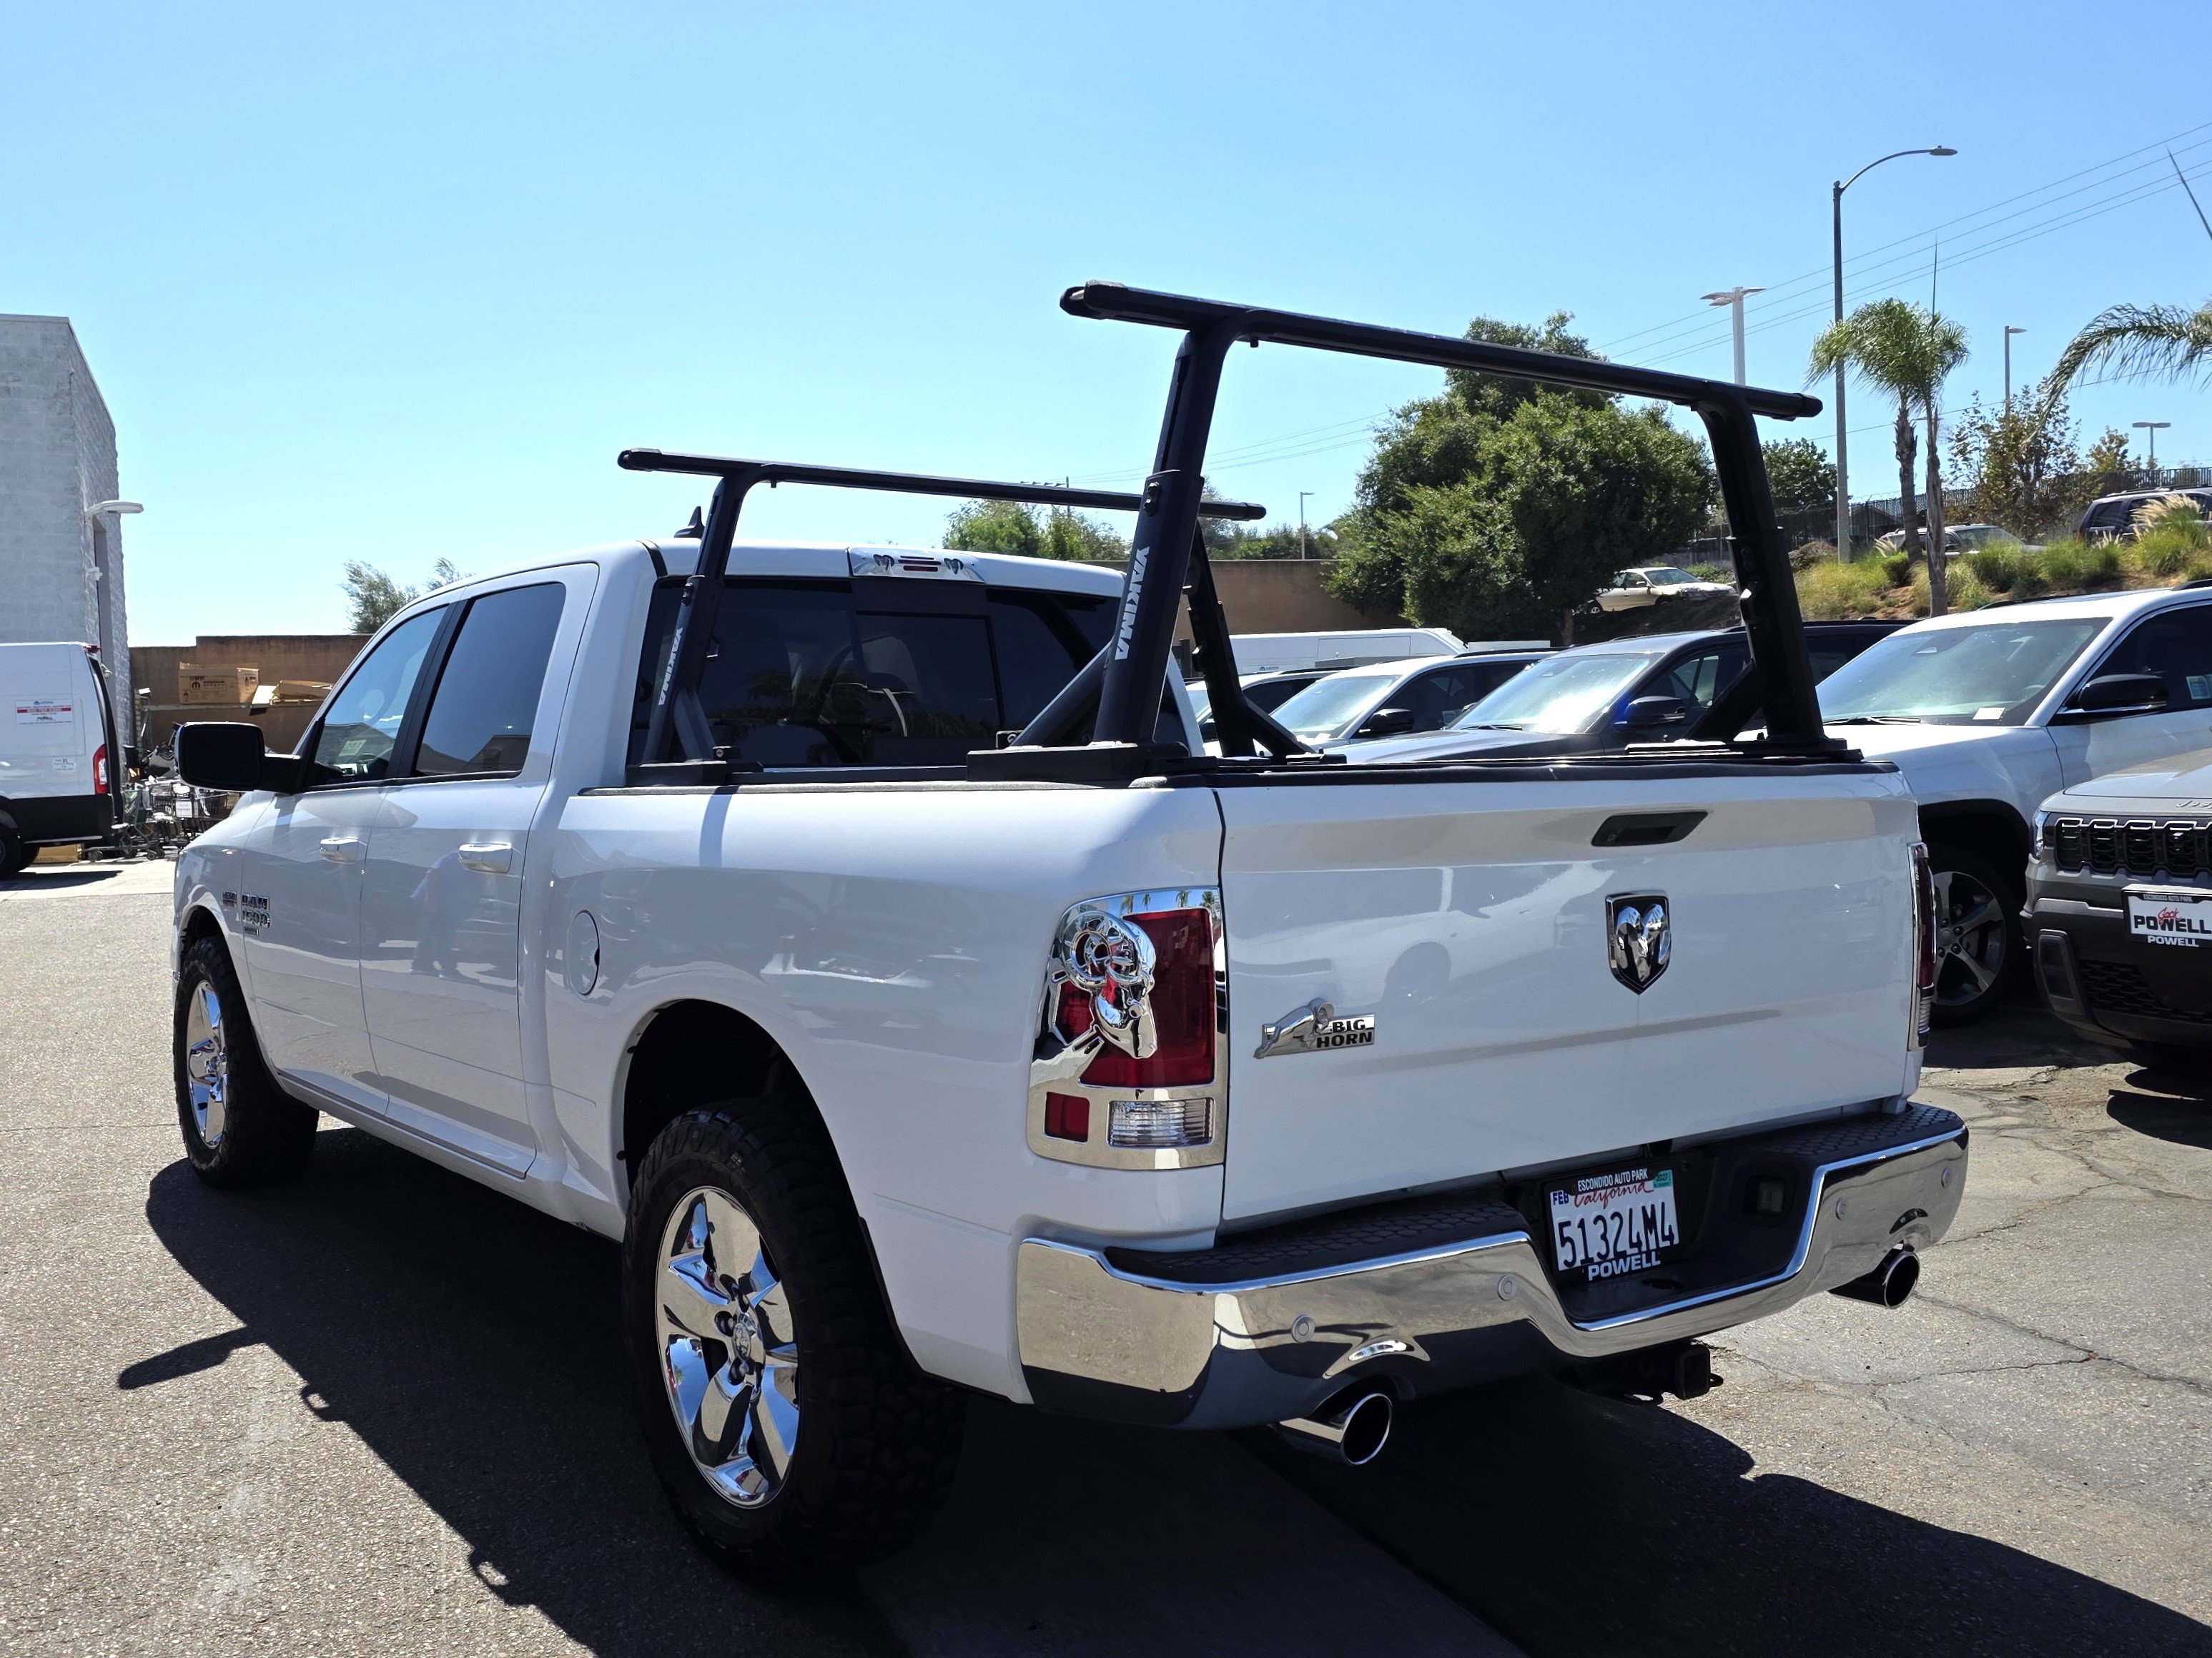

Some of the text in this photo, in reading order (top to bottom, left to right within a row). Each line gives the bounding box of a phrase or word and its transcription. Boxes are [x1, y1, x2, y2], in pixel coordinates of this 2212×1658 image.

[1115, 546, 1150, 660] YAKIMA
[658, 628, 683, 705] YAKIMA
[242, 894, 270, 912] RAM
[242, 909, 271, 928] 1500
[2134, 915, 2212, 934] POWELL
[2147, 935, 2200, 947] POWELL
[1332, 1019, 1366, 1033] BIG
[1316, 1032, 1373, 1048] HORN
[1578, 1168, 1649, 1192] ESCONDIDO AUTO PARK
[1552, 1191, 1569, 1206] FEB
[1574, 1181, 1654, 1210] California
[1557, 1201, 1675, 1268] 51324M4
[1588, 1251, 1661, 1281] POWELL
